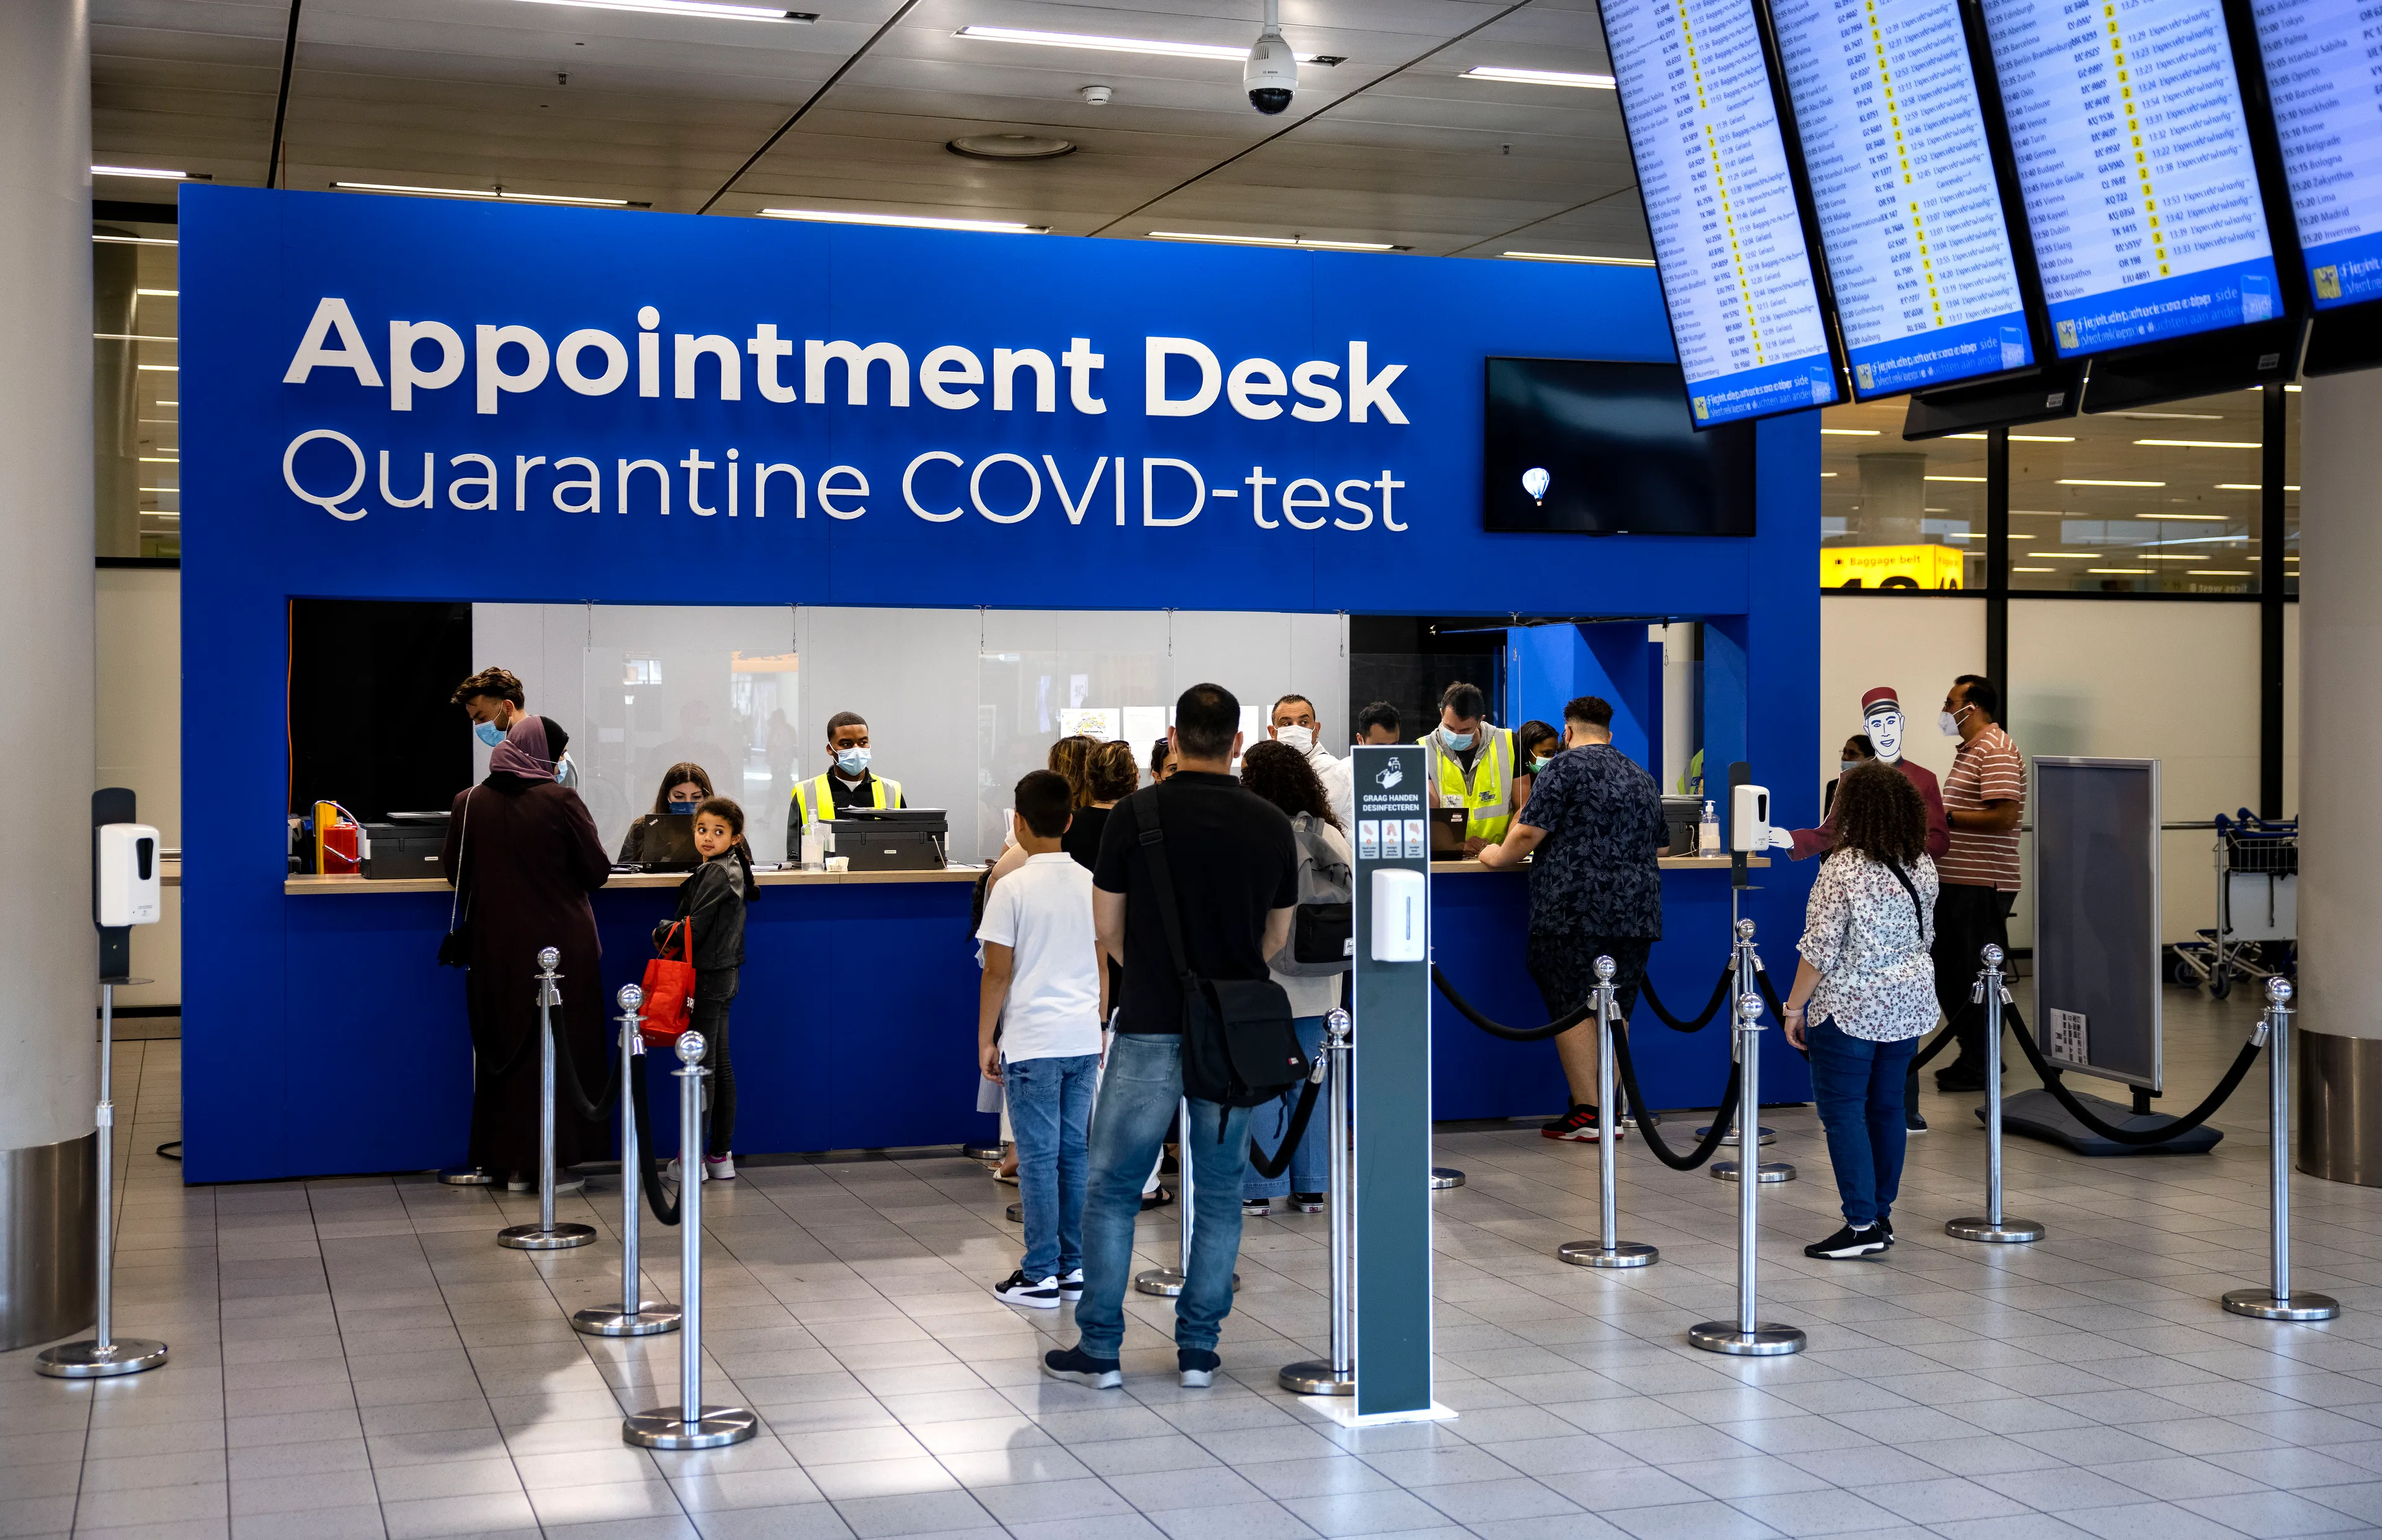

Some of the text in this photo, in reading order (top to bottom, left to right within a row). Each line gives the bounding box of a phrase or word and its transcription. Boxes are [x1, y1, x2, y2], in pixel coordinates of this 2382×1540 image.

[1987, 2, 2035, 26] 13:35 Edinburgh
[1991, 20, 2036, 42] 13:35 Aberdeen
[2259, 22, 2279, 35] 15:00
[1994, 35, 2040, 57] 13:35 Barcelona
[2263, 33, 2308, 52] 15:05 Palma
[1783, 51, 1796, 61] 13:00
[1796, 46, 1811, 56] Palma
[1997, 38, 2074, 72] 13:35 Berlin Brandenburg
[2266, 39, 2347, 70] 15:05 Istanbul Sabiha
[2001, 69, 2036, 87] 13:35 Zurich
[2270, 74, 2290, 87] 15:05
[2004, 87, 2034, 103] 13:40 Oslo
[2273, 82, 2334, 105] 15:10 Barcelona
[2007, 99, 2050, 118] 13:40 Toulouse
[2277, 99, 2340, 122] 15:10 Stockholm
[2010, 117, 2047, 133] 13:40 Venice
[2280, 122, 2324, 140] 15:10 Rome
[2014, 133, 2046, 148] 13:40 Turin
[2284, 135, 2340, 158] 15:10 Belgrade
[2017, 148, 2056, 163] 13:40 Geneva
[1811, 151, 1888, 184] 13:10 Istanbul Airport TK 1957
[2020, 161, 2064, 179] 13:40 Budapest
[2288, 155, 2342, 174] 15:15 Bologna
[1814, 166, 1891, 198] 13:10 Alicante VY 1377
[2023, 171, 2084, 194] 13:45 Paris de Gaulle
[2291, 179, 2312, 192] 15:20
[1820, 195, 1896, 225] 13:15 Malaga OR 518
[2027, 194, 2065, 209] 13:45 Vienna
[2030, 191, 2128, 225] 13:50 Kayseri XQ 722
[2295, 194, 2336, 209] 15:20 Lima
[1823, 209, 1898, 238] 13:15 Dubai International EK 147
[2299, 207, 2349, 226] 15:20 Madrid
[2033, 225, 2071, 239] 13:50 Dublin
[2036, 223, 2137, 255] 13:55 Elazig TK 1415
[2302, 231, 2323, 243] 15:20
[1829, 254, 1854, 265] 13:15 Lyon
[2040, 256, 2074, 269] 14:00 Doha
[2043, 256, 2141, 285] 14:00 Karpathos OR 198
[1835, 275, 1877, 292] 13:20 Thessaloniki
[2046, 290, 2063, 300] 14:00
[2063, 286, 2084, 296] Naples
[2134, 270, 2150, 280] 4891
[2215, 285, 2239, 302] side
[1841, 304, 1884, 319] 13:20 Gothenburg
[2190, 312, 2209, 325] aan
[1844, 319, 1881, 332] 13:20 Bordeaux
[1847, 334, 1881, 345] 13:20 Aalborg
[1979, 336, 1998, 350] side
[283, 298, 1409, 424] Appointment Desk
[1960, 359, 1976, 370] aan
[1795, 374, 1809, 387] side
[1780, 393, 1792, 403] aan
[283, 430, 1408, 531] Quarantine COVID-test
[1850, 555, 1920, 567] Baggage belt
[1363, 803, 1419, 811] DESINFECTEREN
